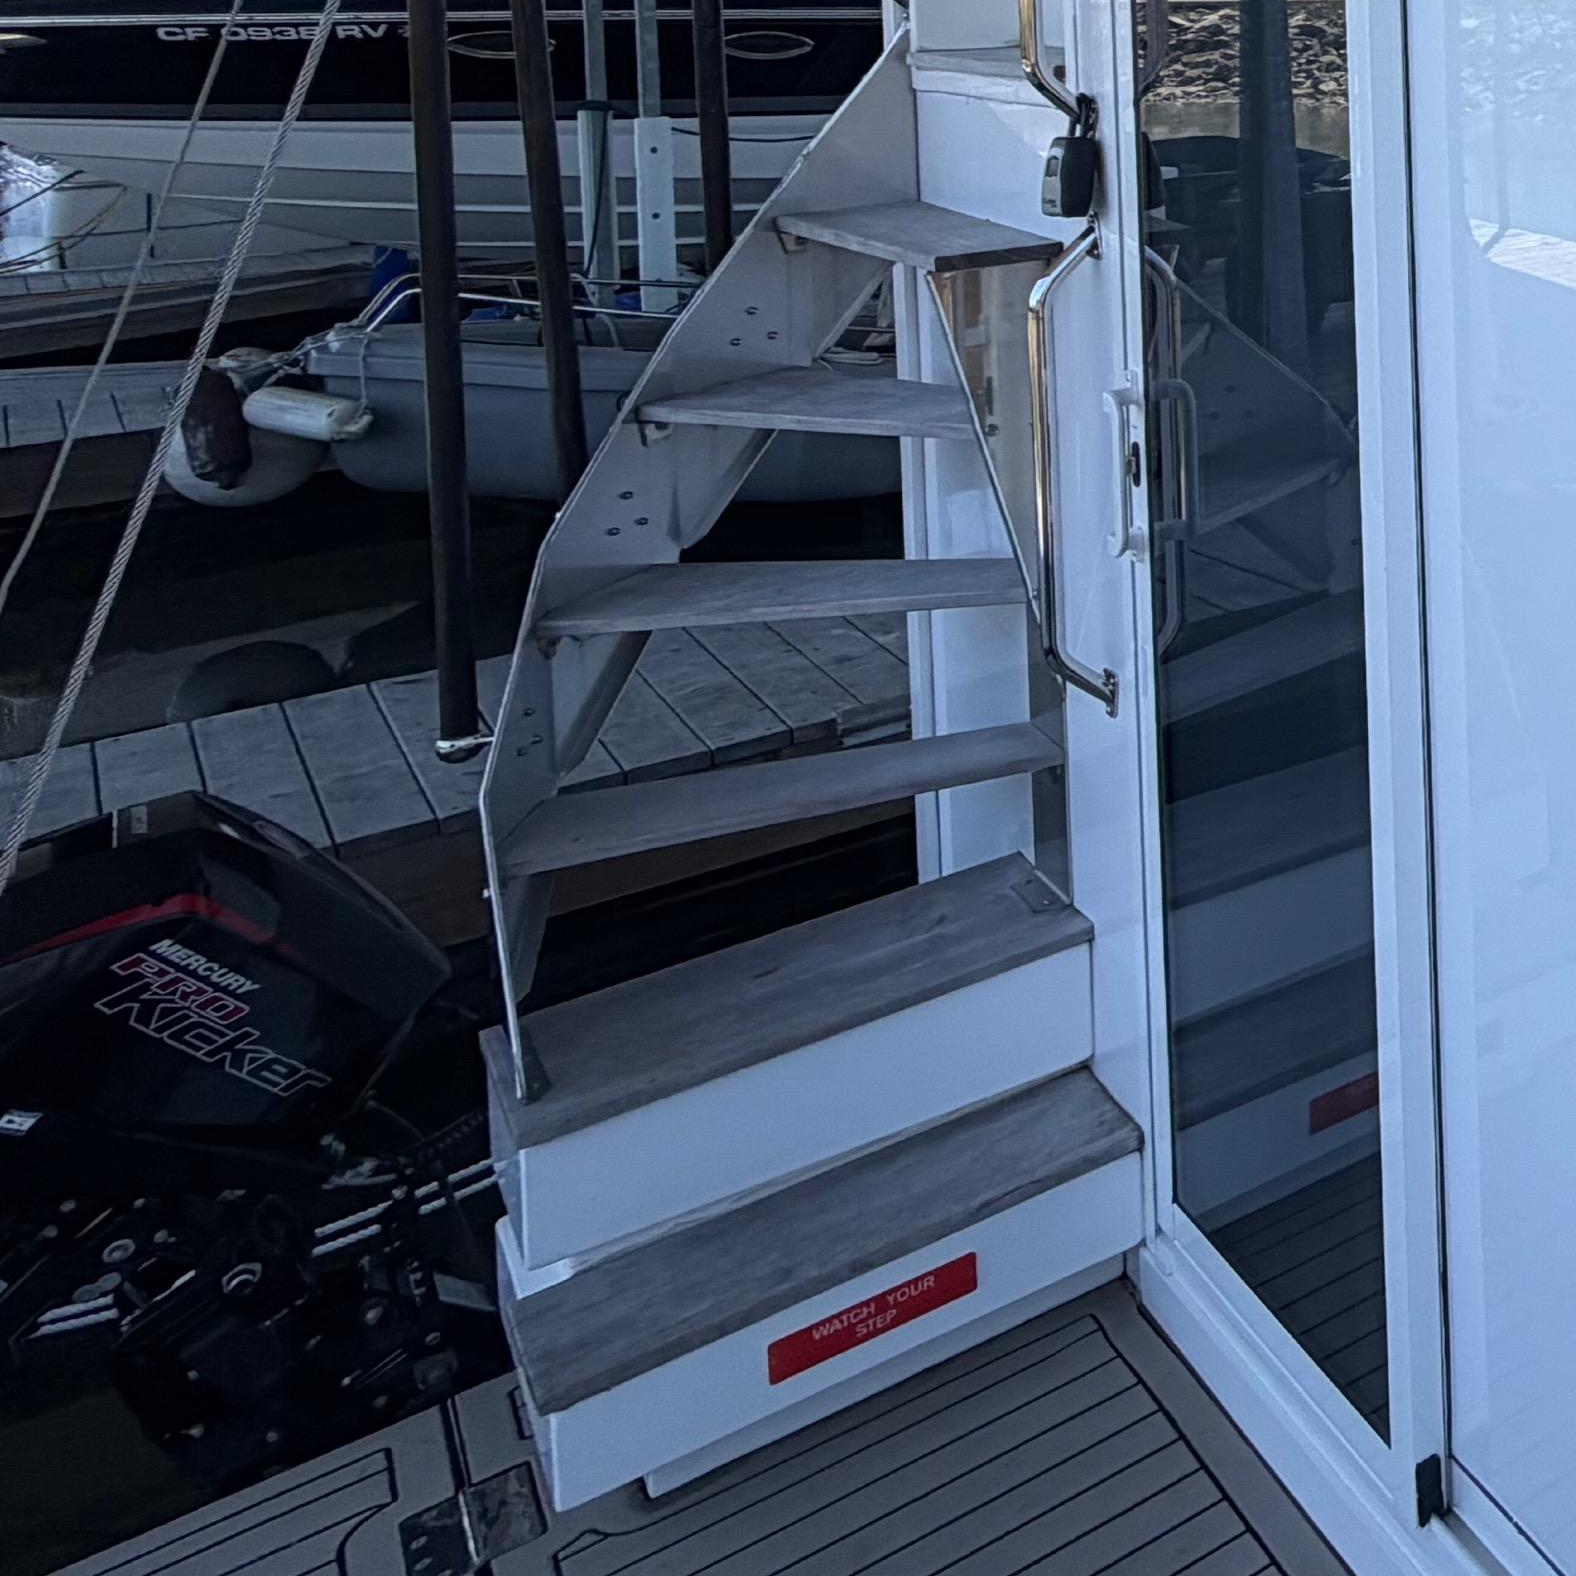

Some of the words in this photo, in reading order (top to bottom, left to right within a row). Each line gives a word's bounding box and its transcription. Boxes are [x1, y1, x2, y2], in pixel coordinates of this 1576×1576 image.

[155, 26, 211, 41] CF
[334, 24, 389, 39] RV
[108, 952, 250, 1026] PRO
[148, 937, 262, 995] MERCURY
[811, 1302, 876, 1341] WATCH
[885, 1274, 936, 1306] YOUR
[854, 1309, 897, 1339] STEP
